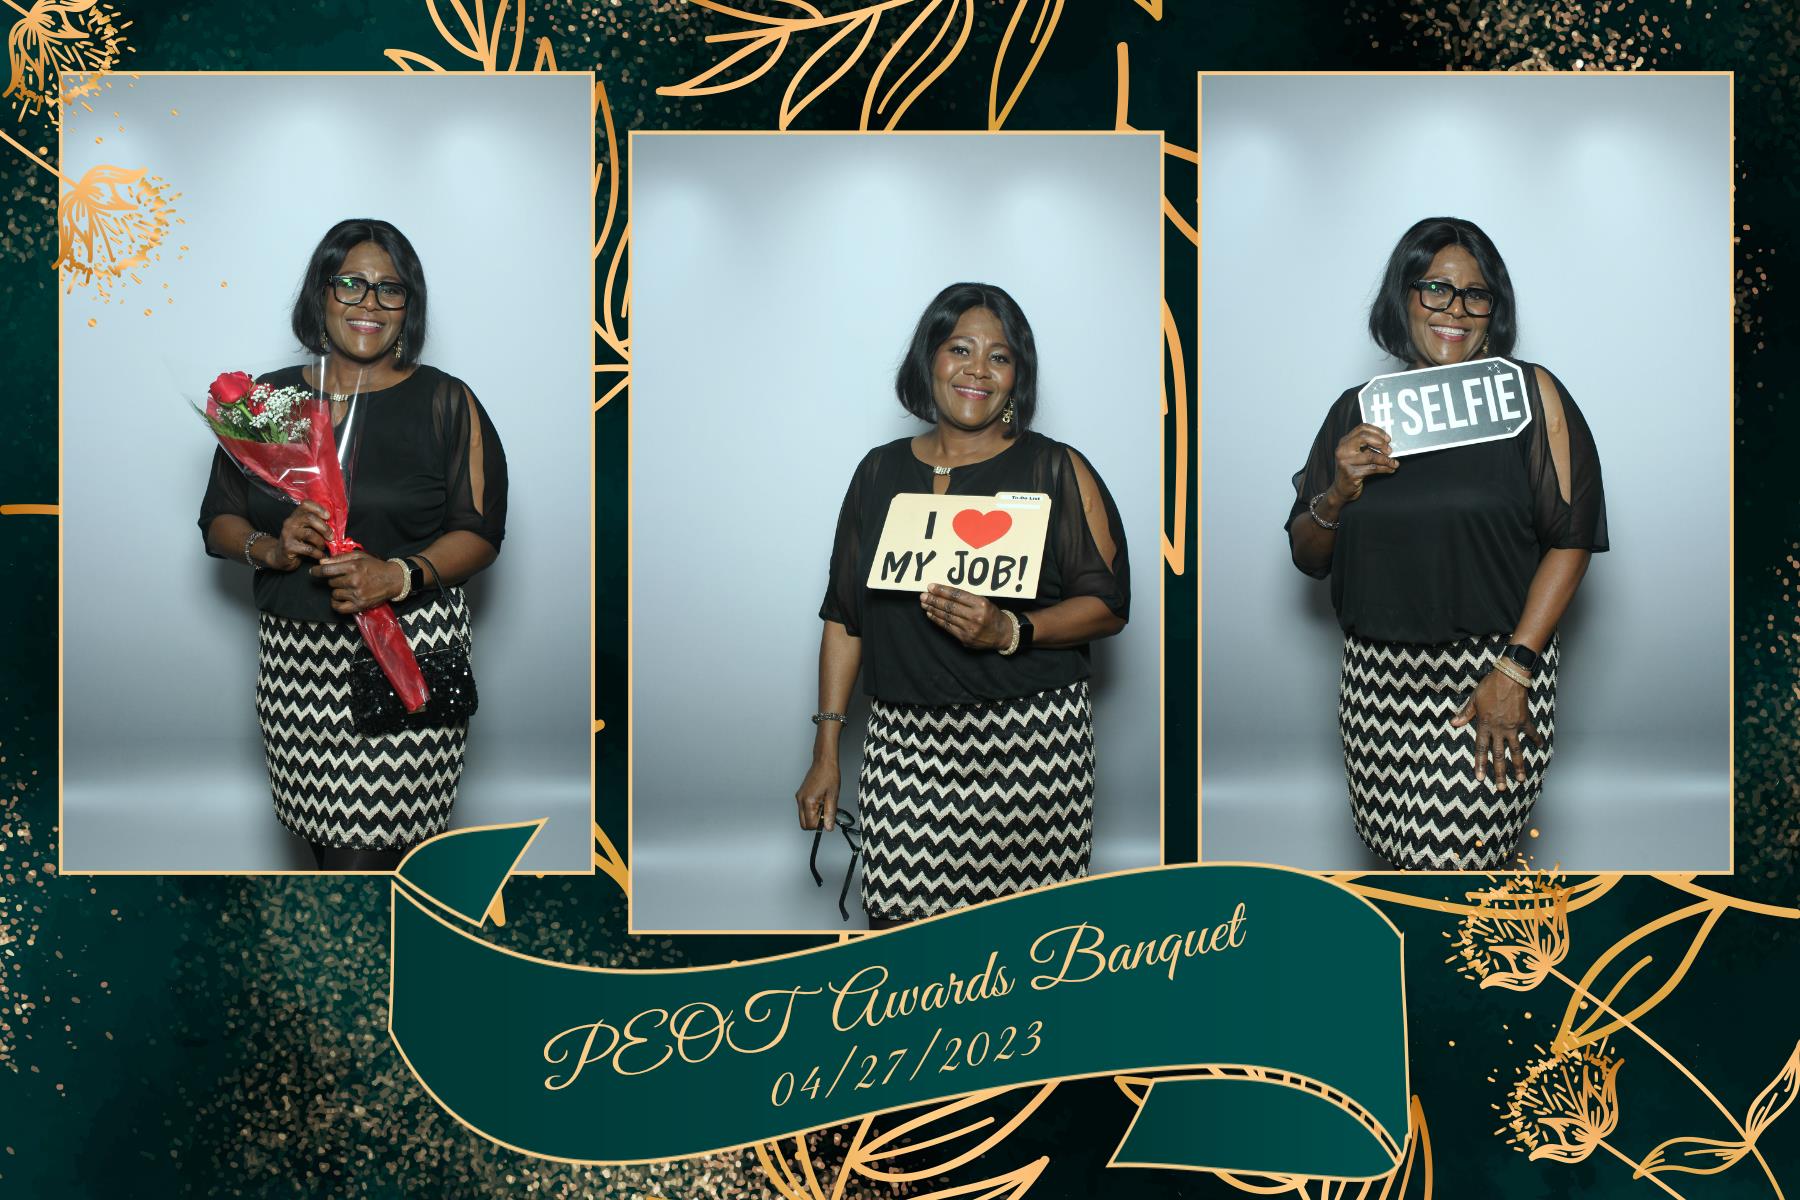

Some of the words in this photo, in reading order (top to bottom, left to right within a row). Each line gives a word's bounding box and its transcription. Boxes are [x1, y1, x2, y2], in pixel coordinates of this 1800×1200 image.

[1371, 373, 1521, 439] #SELFIE
[925, 511, 937, 539] I
[881, 550, 937, 583] MY
[947, 550, 1028, 592] JOB!
